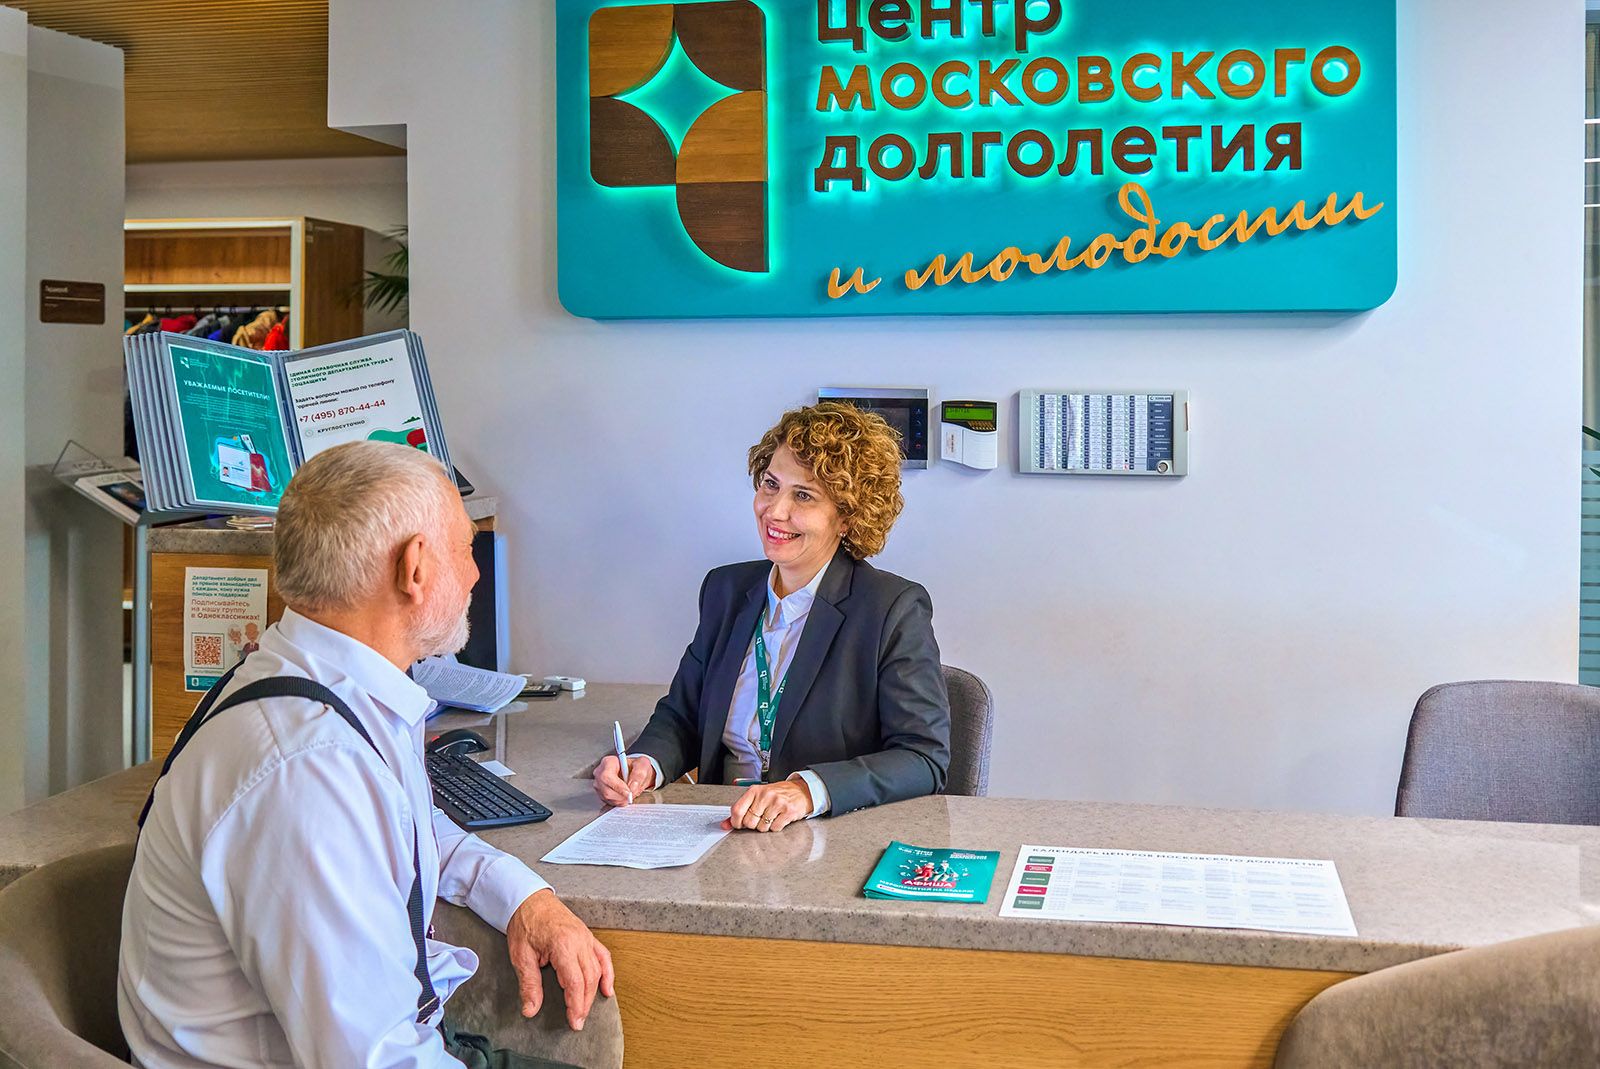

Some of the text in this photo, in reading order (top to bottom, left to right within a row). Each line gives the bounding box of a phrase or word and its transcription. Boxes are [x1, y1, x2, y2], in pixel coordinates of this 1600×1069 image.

[816, 46, 1361, 111] московского
[815, 122, 1302, 192] долголетия
[828, 182, 1384, 298] и молодости
[312, 362, 349, 373] СПРАВОЧНАЯ
[350, 357, 373, 366] СЛУЖБА
[328, 363, 370, 375] ДЕПАРТАМЕНТА
[370, 359, 389, 367] ТРУДА
[183, 379, 270, 400] УВАЖАЕМЫЕ ПОСЕТИТЕЛИ!
[315, 391, 340, 401] вопросы
[368, 379, 395, 389] телефону
[299, 399, 386, 423] +7 (495) 870-44-44
[317, 420, 365, 433] КРУГЛОСУТОЧНО
[191, 599, 250, 607] Подписывайтесь
[197, 612, 260, 621] Одноклассниках!
[1032, 847, 1099, 856] КАЛЕНДАРЬ
[1157, 854, 1244, 862] МОСКОВСКОГО
[1246, 859, 1324, 867] ДОЛГОЛЕТИЯ
[904, 880, 953, 888] АФИША
